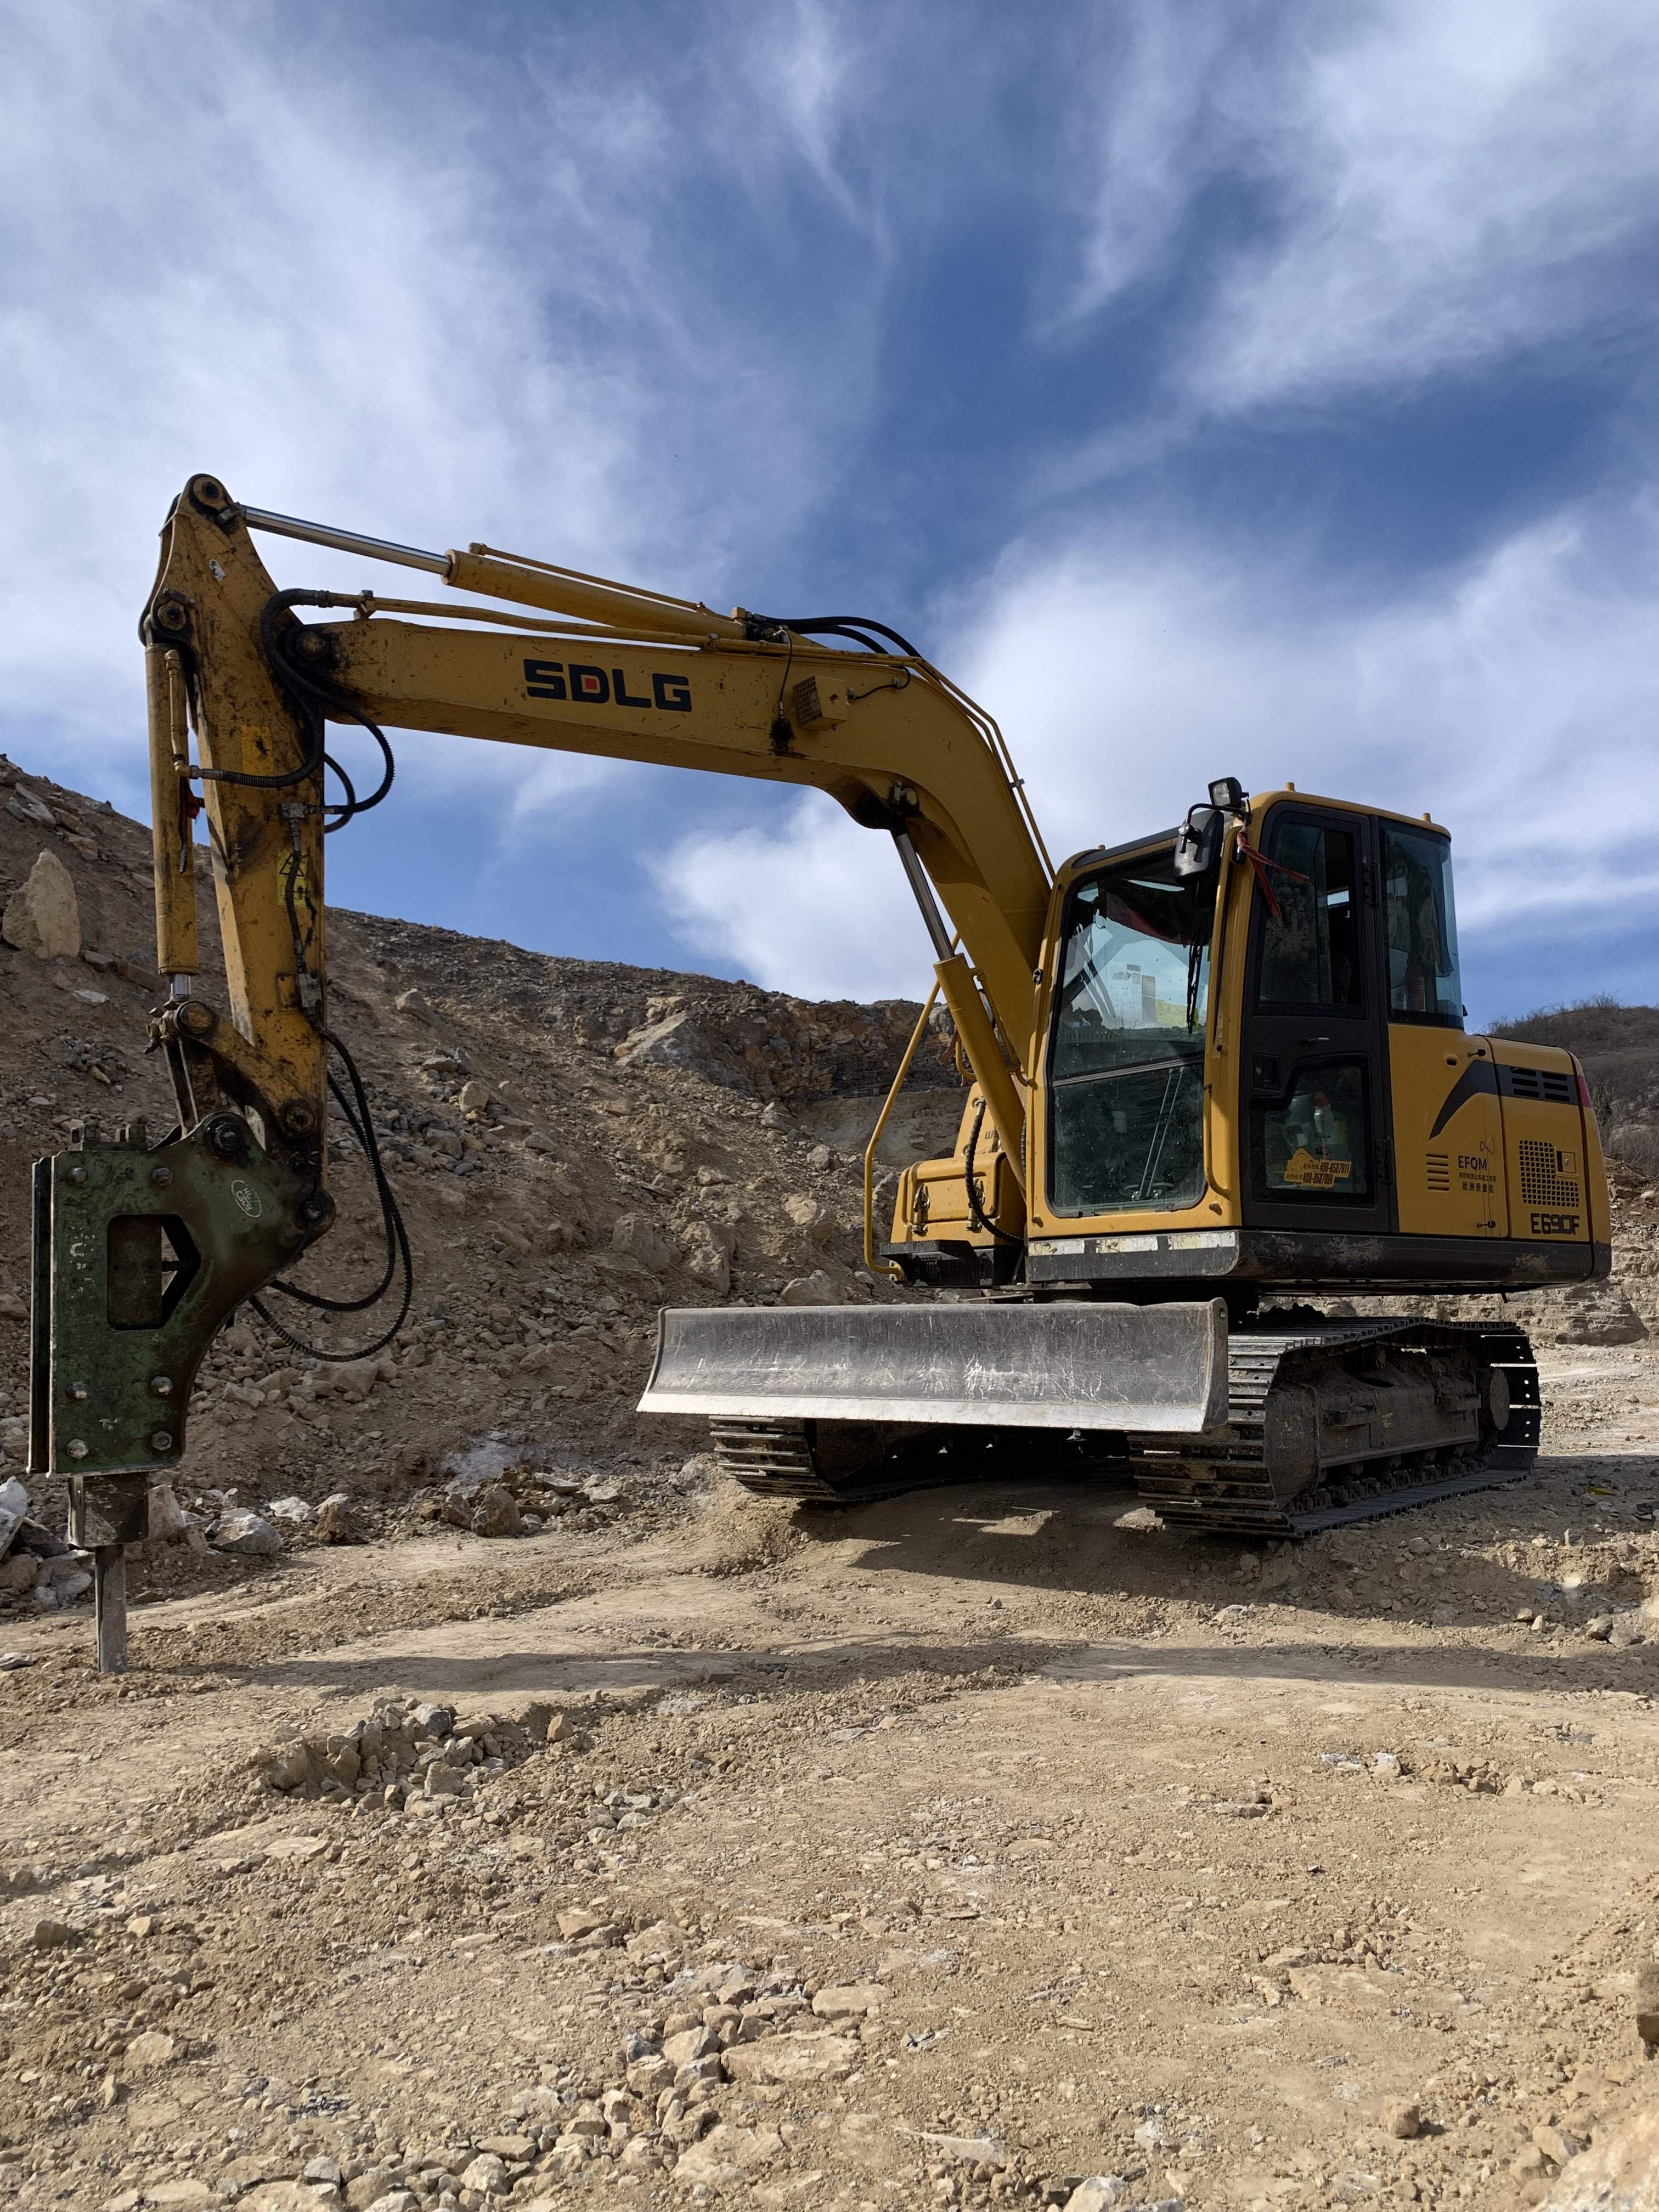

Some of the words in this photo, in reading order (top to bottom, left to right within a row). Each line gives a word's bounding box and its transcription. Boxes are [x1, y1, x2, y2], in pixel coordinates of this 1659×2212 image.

[523, 658, 692, 712] SDLG
[1458, 1155, 1487, 1172] EFQM
[1530, 1212, 1580, 1235] E690F
